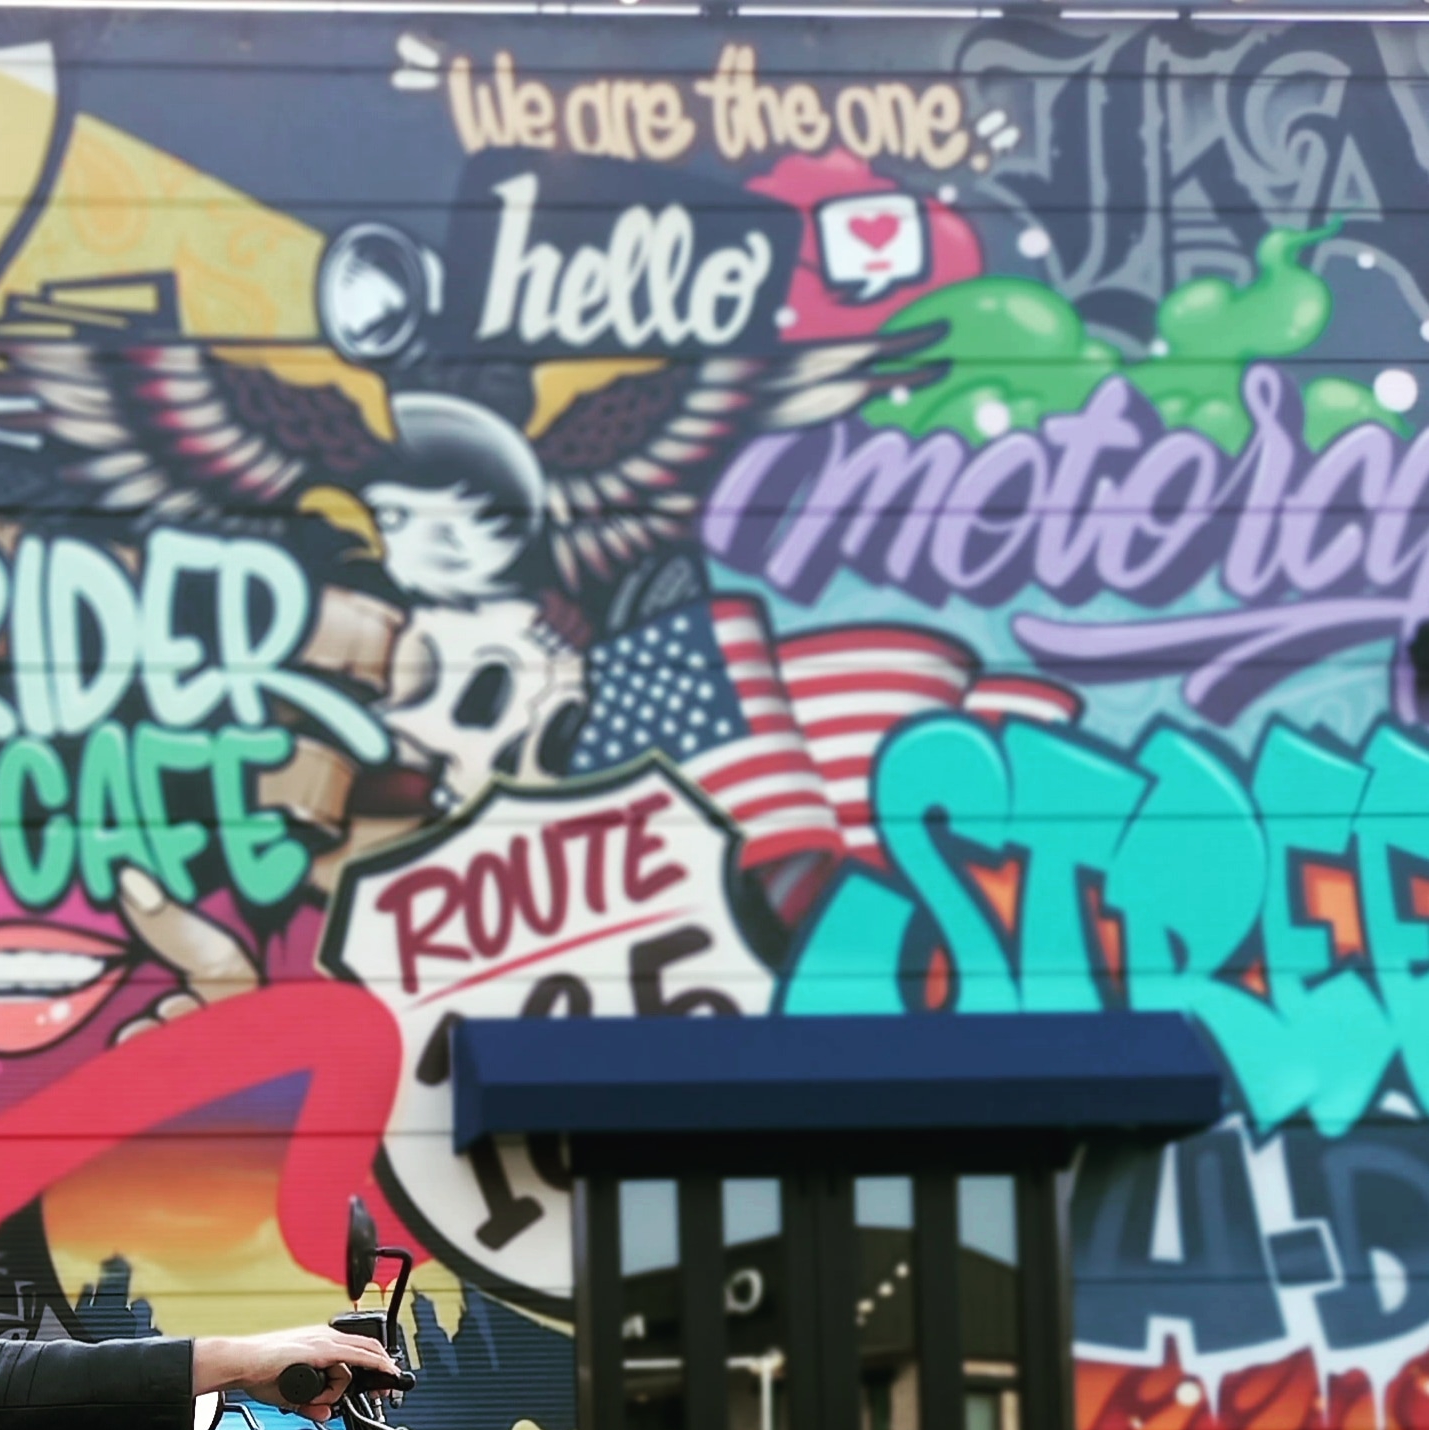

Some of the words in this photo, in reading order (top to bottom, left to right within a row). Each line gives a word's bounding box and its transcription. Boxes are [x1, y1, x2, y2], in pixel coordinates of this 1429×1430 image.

[564, 78, 696, 160] are
[696, 44, 831, 158] the
[476, 172, 772, 347] hello
[374, 791, 690, 994] ROUTE
